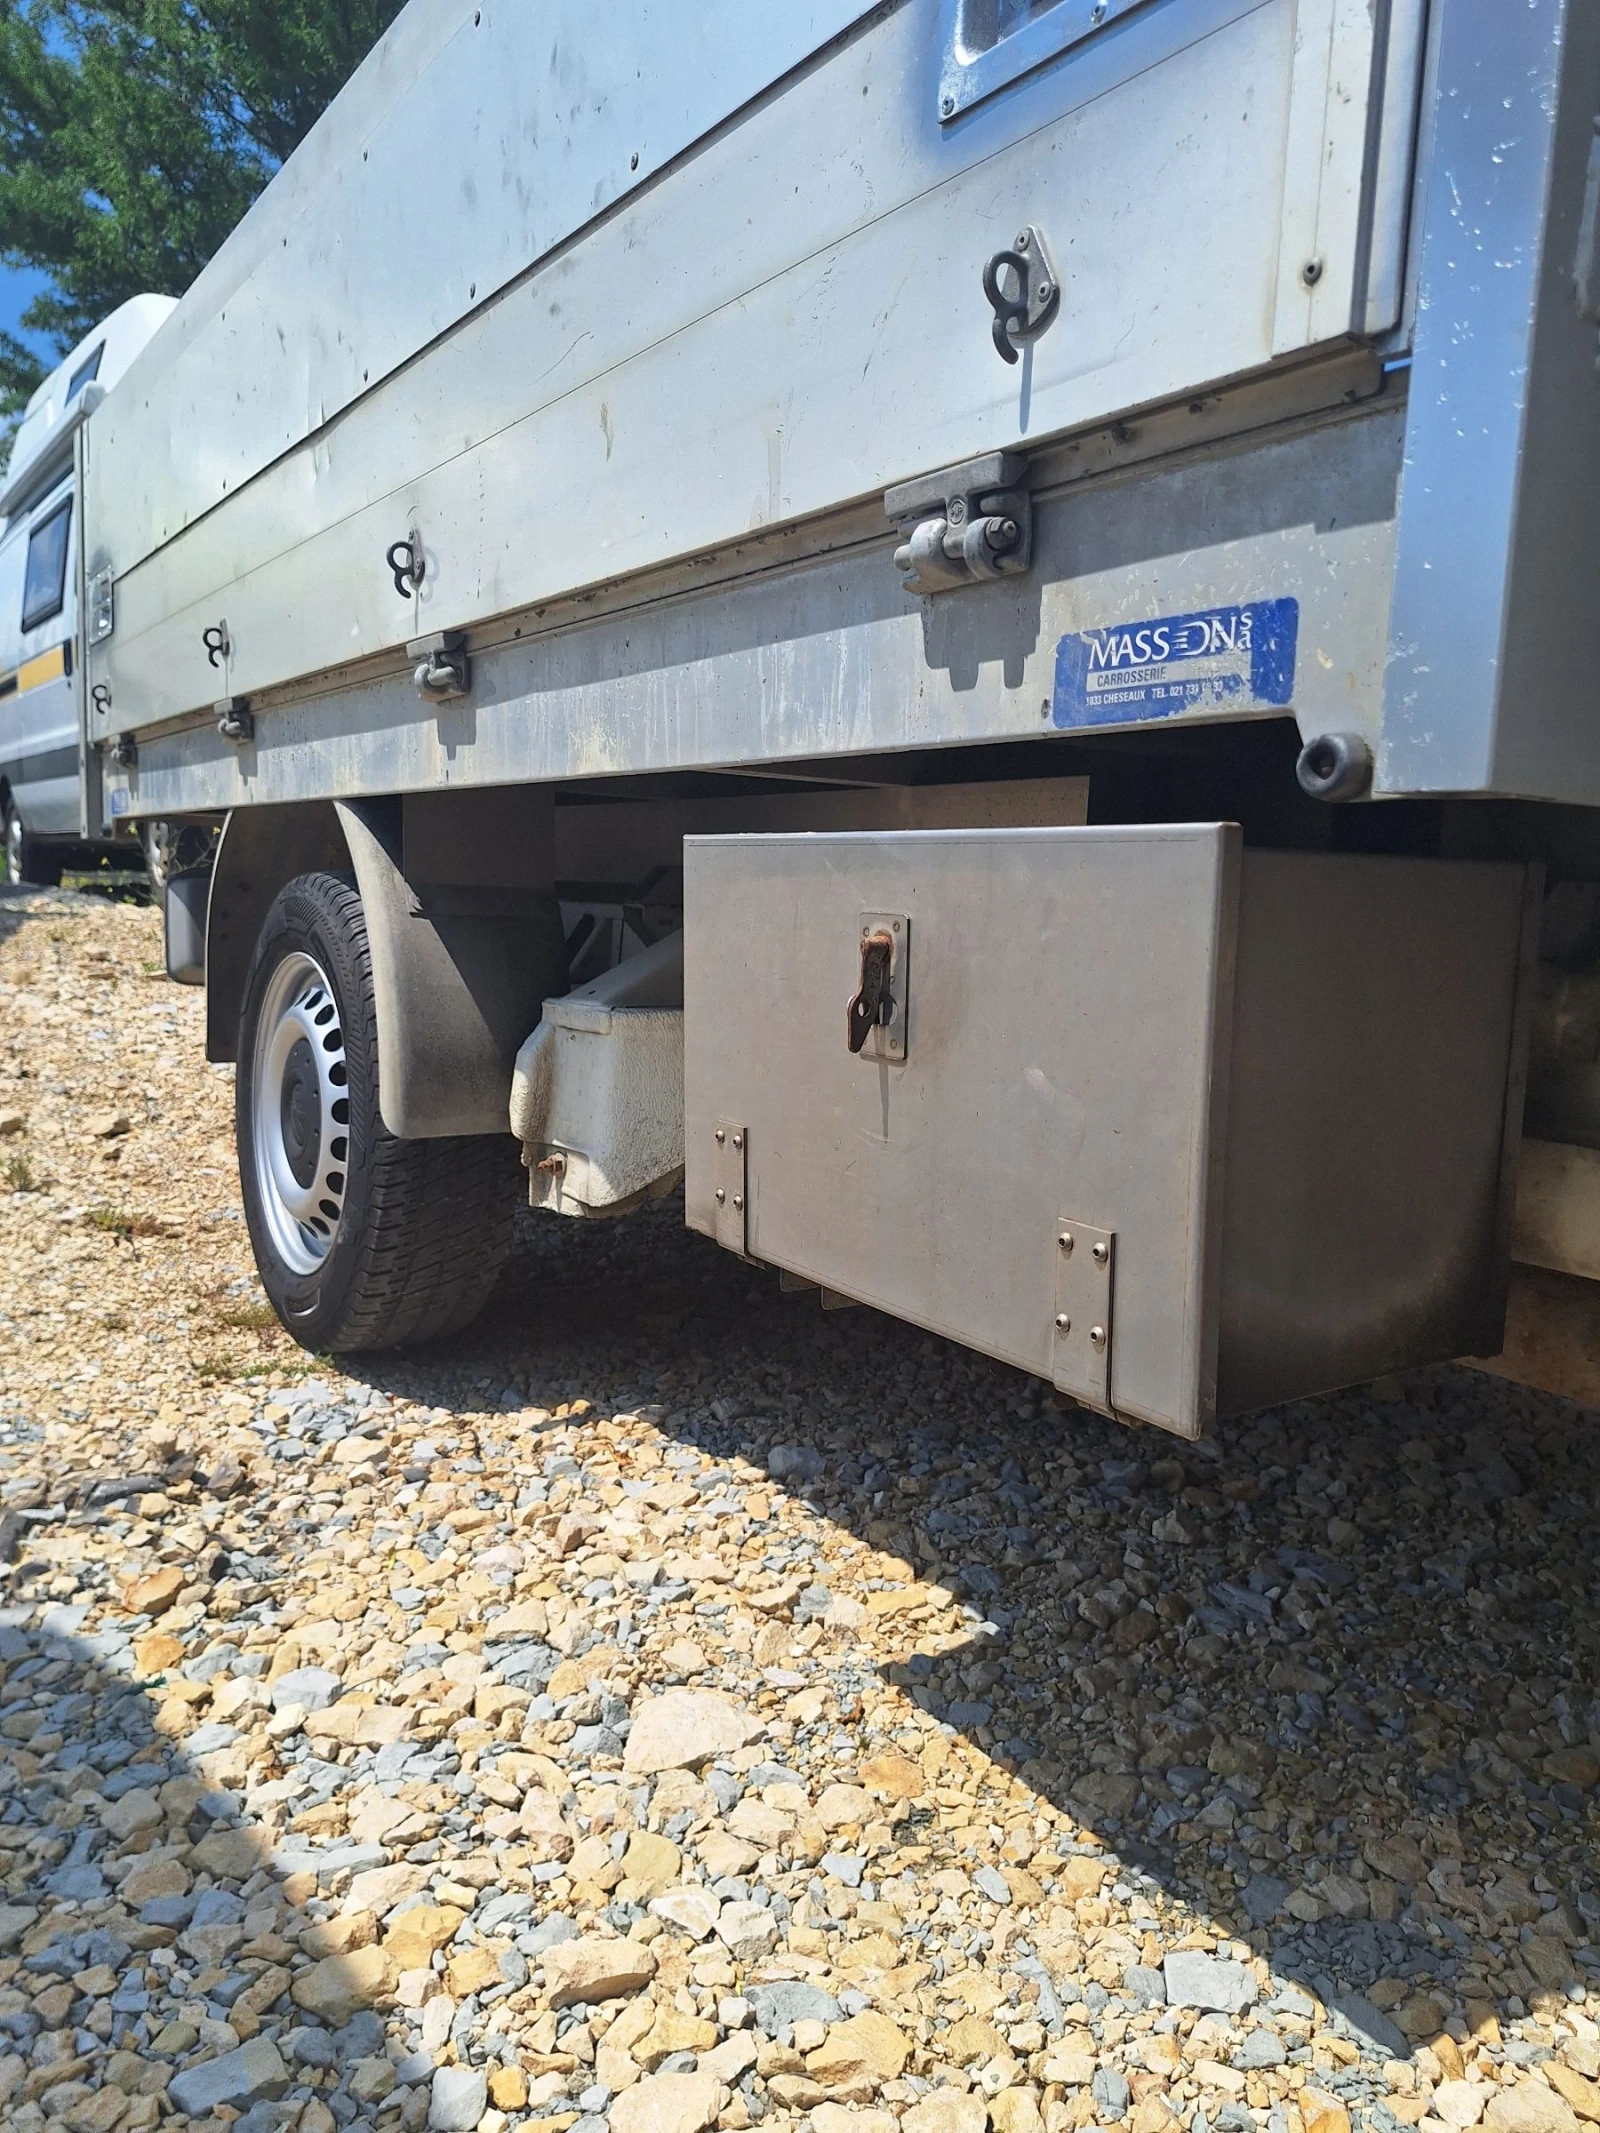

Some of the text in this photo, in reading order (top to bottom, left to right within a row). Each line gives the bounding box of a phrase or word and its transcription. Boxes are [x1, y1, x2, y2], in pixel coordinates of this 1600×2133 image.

[1088, 616, 1237, 669] MASSON
[1097, 666, 1167, 688] CARROSSERIE
[1086, 695, 1102, 706] 1033
[1103, 690, 1146, 704] CHESEAUX
[1151, 687, 1169, 699] TEL.
[1170, 685, 1183, 697] 021
